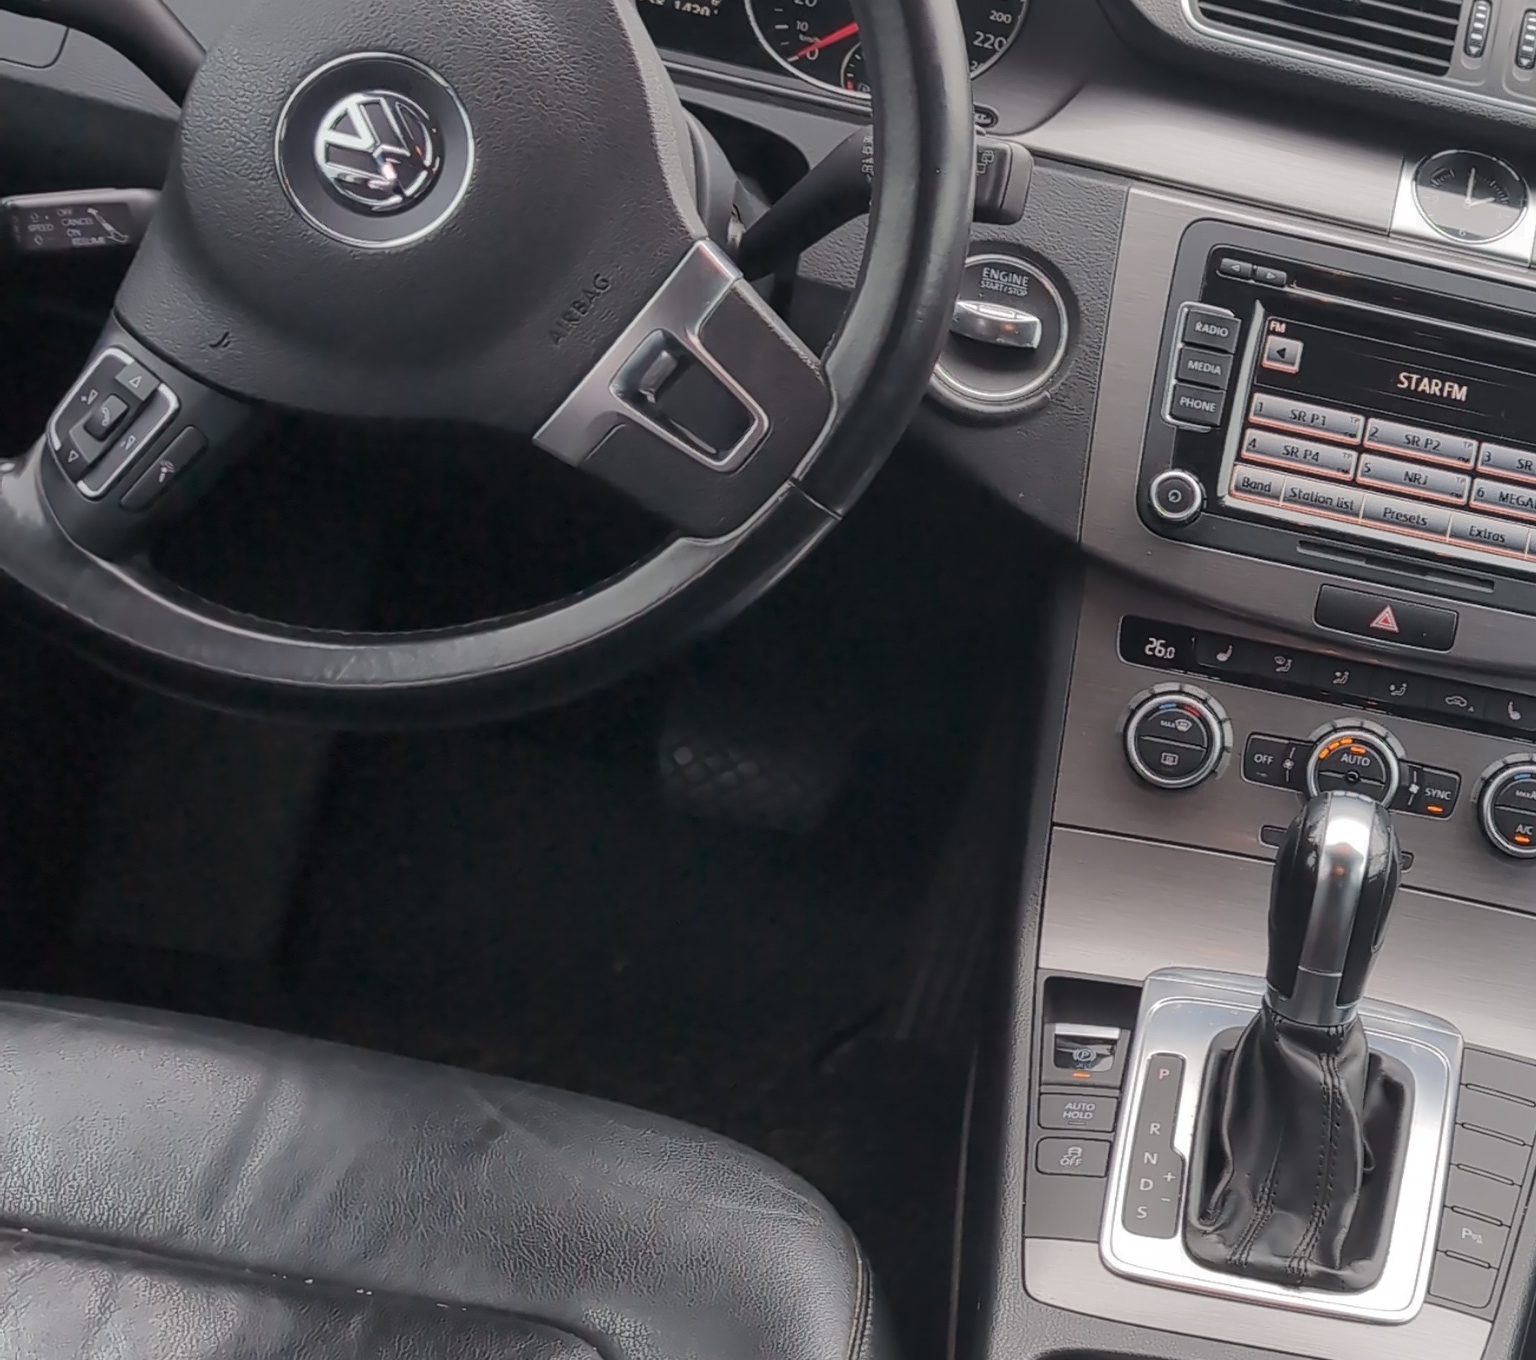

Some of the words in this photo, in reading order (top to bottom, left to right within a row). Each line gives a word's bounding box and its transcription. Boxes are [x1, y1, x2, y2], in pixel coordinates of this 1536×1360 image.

[989, 10, 1012, 24] 200
[796, 20, 809, 32] 10
[973, 31, 1008, 51] 220
[982, 266, 1030, 287] ENGINE
[548, 272, 610, 346] AIRBAG
[1194, 320, 1229, 338] RADIO
[1269, 320, 1286, 334] FM
[1187, 359, 1222, 376] MEDIA
[1179, 396, 1217, 414] PHONE
[1288, 408, 1307, 422] SR
[1310, 412, 1327, 427] P1
[1370, 426, 1379, 438] 2
[1402, 434, 1420, 447] SR
[1423, 437, 1441, 452] P2
[1248, 438, 1256, 449] 4
[1282, 444, 1299, 458] SR
[1302, 449, 1320, 463] P4
[1484, 450, 1492, 462] 3
[1516, 458, 1533, 471] SR
[1241, 476, 1273, 494] Band
[1403, 470, 1429, 486] NRJ
[1289, 486, 1334, 507] Station
[1335, 496, 1355, 511] list
[1477, 487, 1485, 498] 6
[1382, 506, 1429, 527] Presets
[1468, 524, 1506, 544] Extras
[1253, 753, 1274, 766] OFF
[1340, 753, 1371, 767] AUTO
[1424, 787, 1452, 801] SYNC
[1515, 823, 1535, 836] A/C
[1159, 1068, 1170, 1080] P
[1064, 1101, 1096, 1112] AUTO
[1062, 1110, 1093, 1120] HOLD
[1150, 1122, 1161, 1136] R
[1060, 1156, 1083, 1167] OFF
[1143, 1151, 1158, 1165] N
[1139, 1178, 1154, 1192] D
[1136, 1206, 1148, 1220] S
